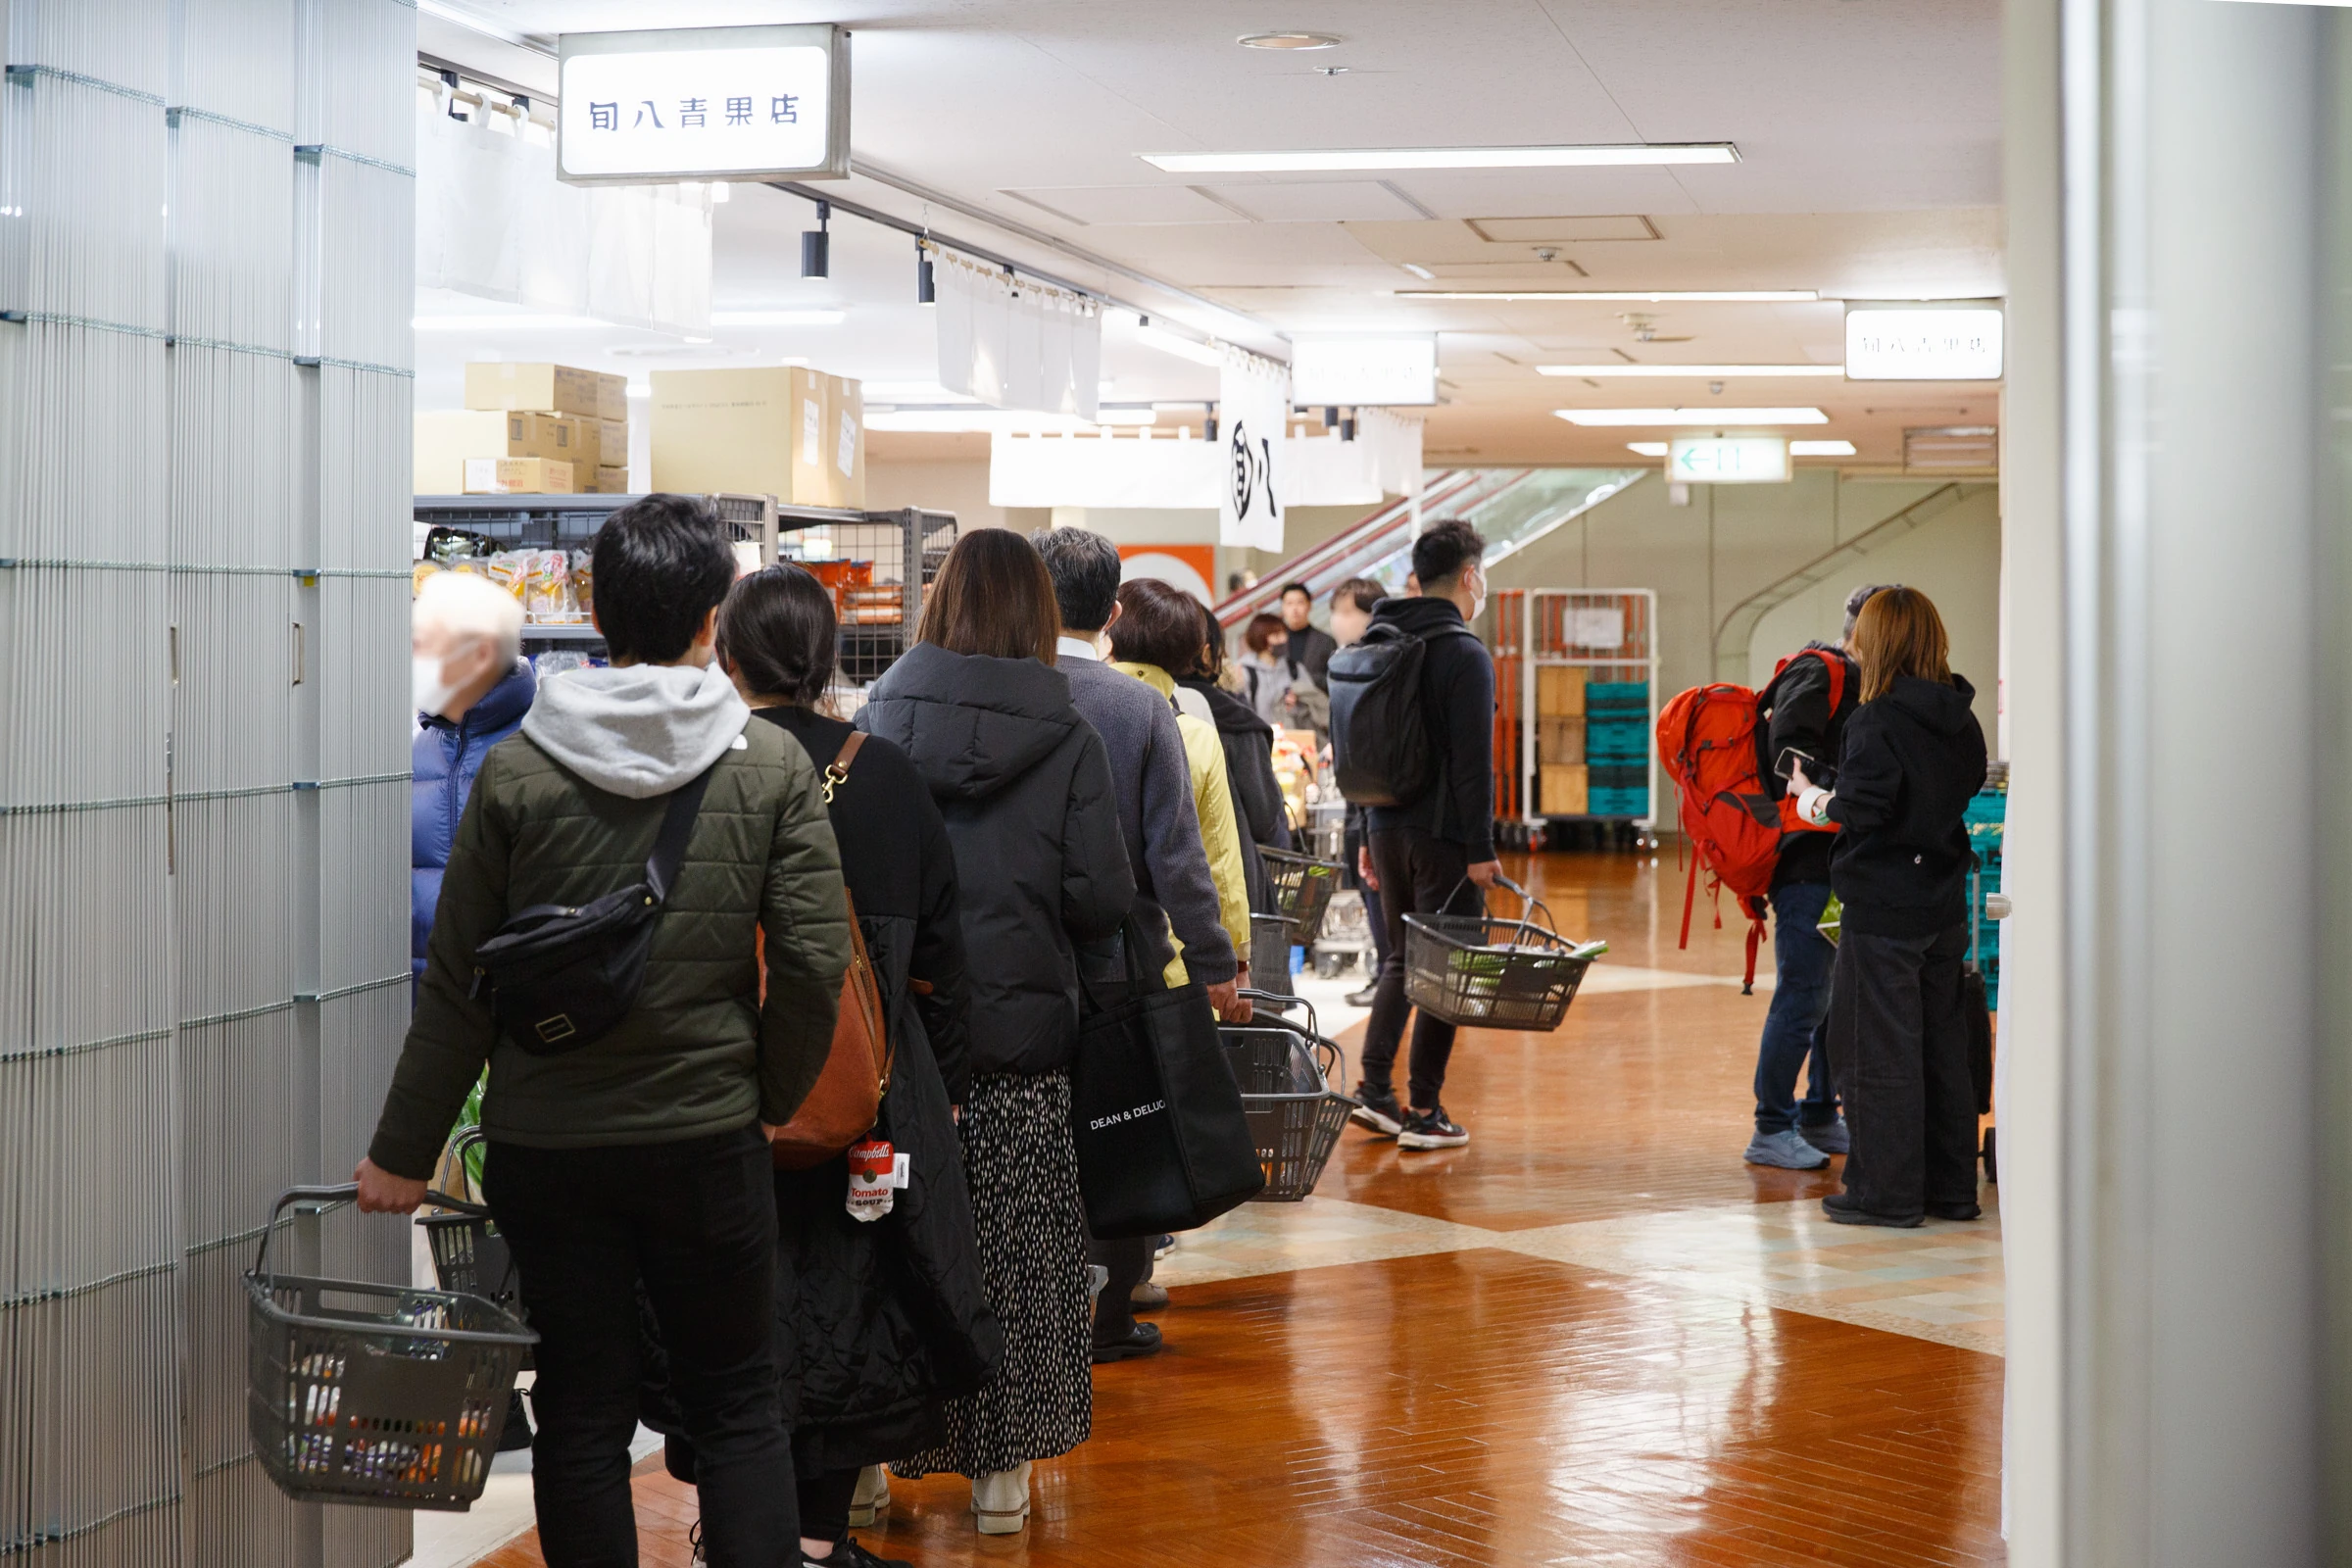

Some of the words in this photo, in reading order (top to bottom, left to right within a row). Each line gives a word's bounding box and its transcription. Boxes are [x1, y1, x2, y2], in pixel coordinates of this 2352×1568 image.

[590, 93, 799, 131] 旬八青果店
[1090, 1113, 1122, 1130] DEAN
[1123, 1110, 1132, 1121] &
[851, 1187, 889, 1198] Tomato
[856, 1198, 883, 1206] SOUP
